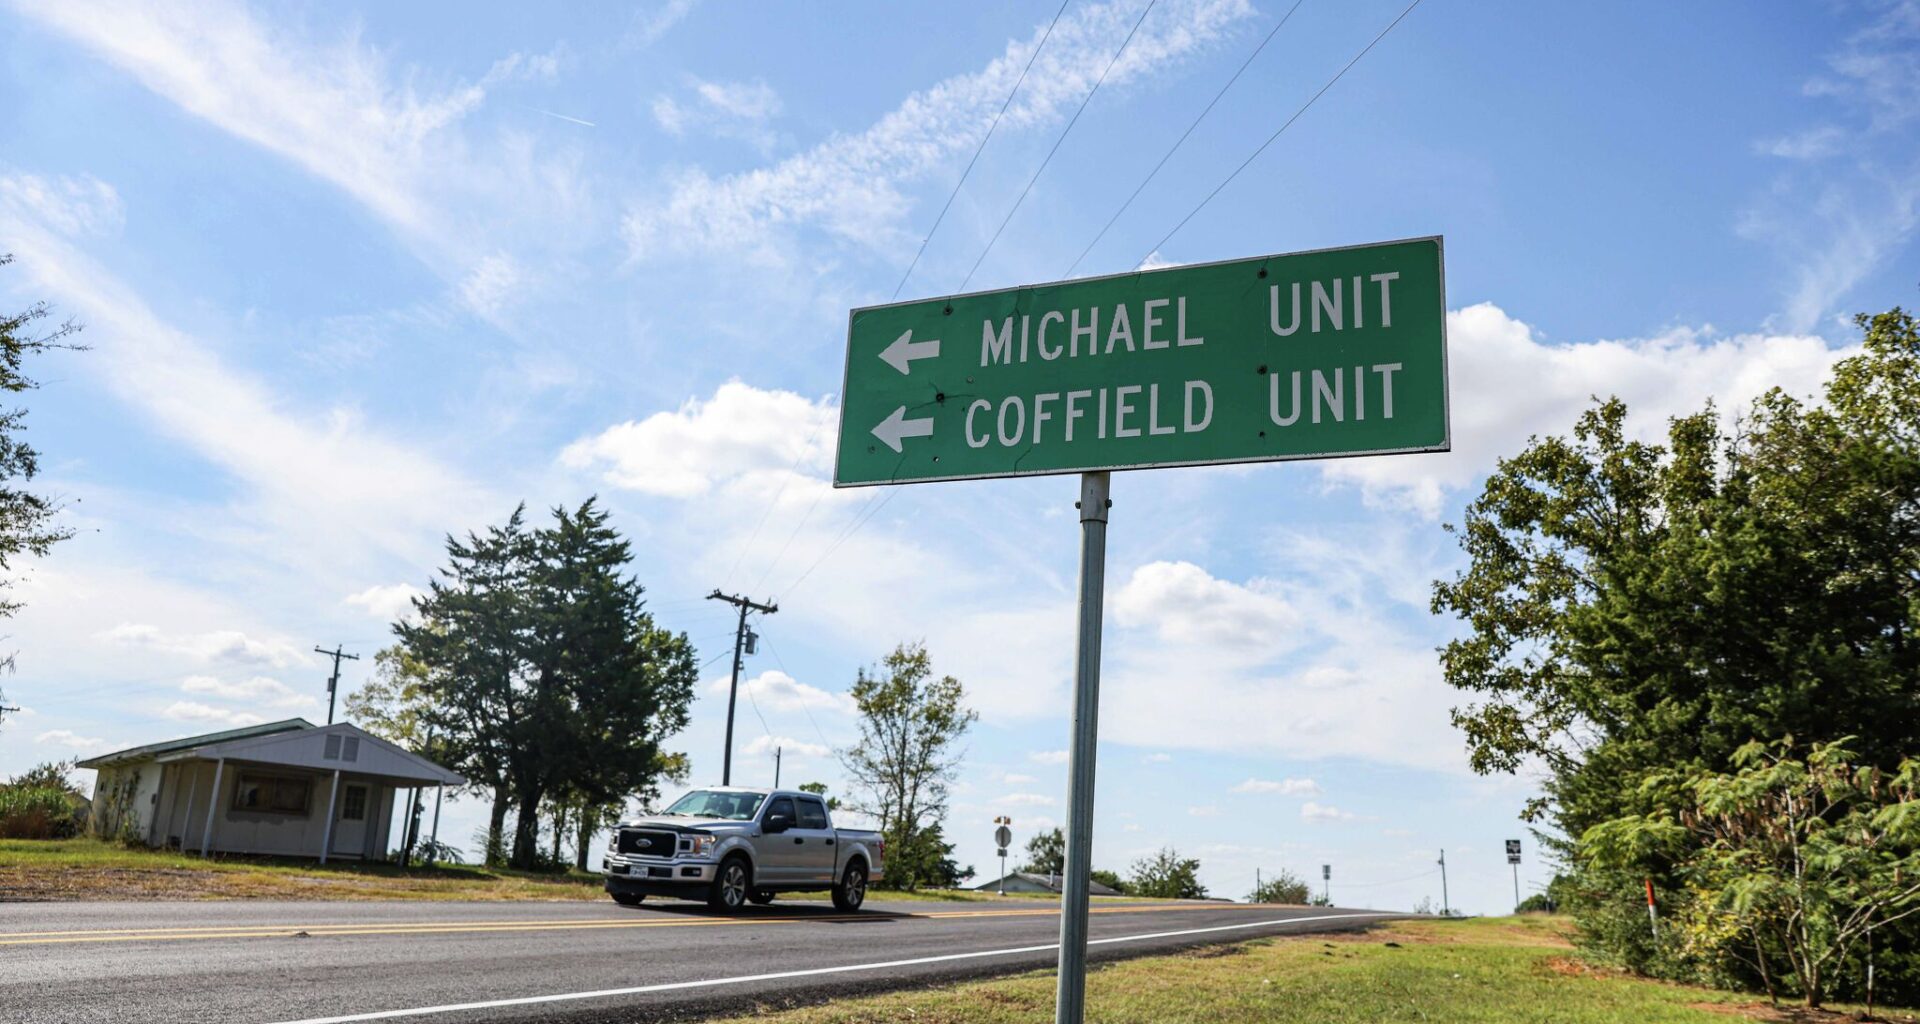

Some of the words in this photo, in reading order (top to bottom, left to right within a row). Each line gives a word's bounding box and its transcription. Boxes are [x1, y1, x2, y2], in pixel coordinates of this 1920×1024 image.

[980, 296, 1204, 367] MICHAEL
[1270, 271, 1400, 337] UNIT
[965, 380, 1214, 448] COFFIELD
[1270, 362, 1402, 427] UNIT
